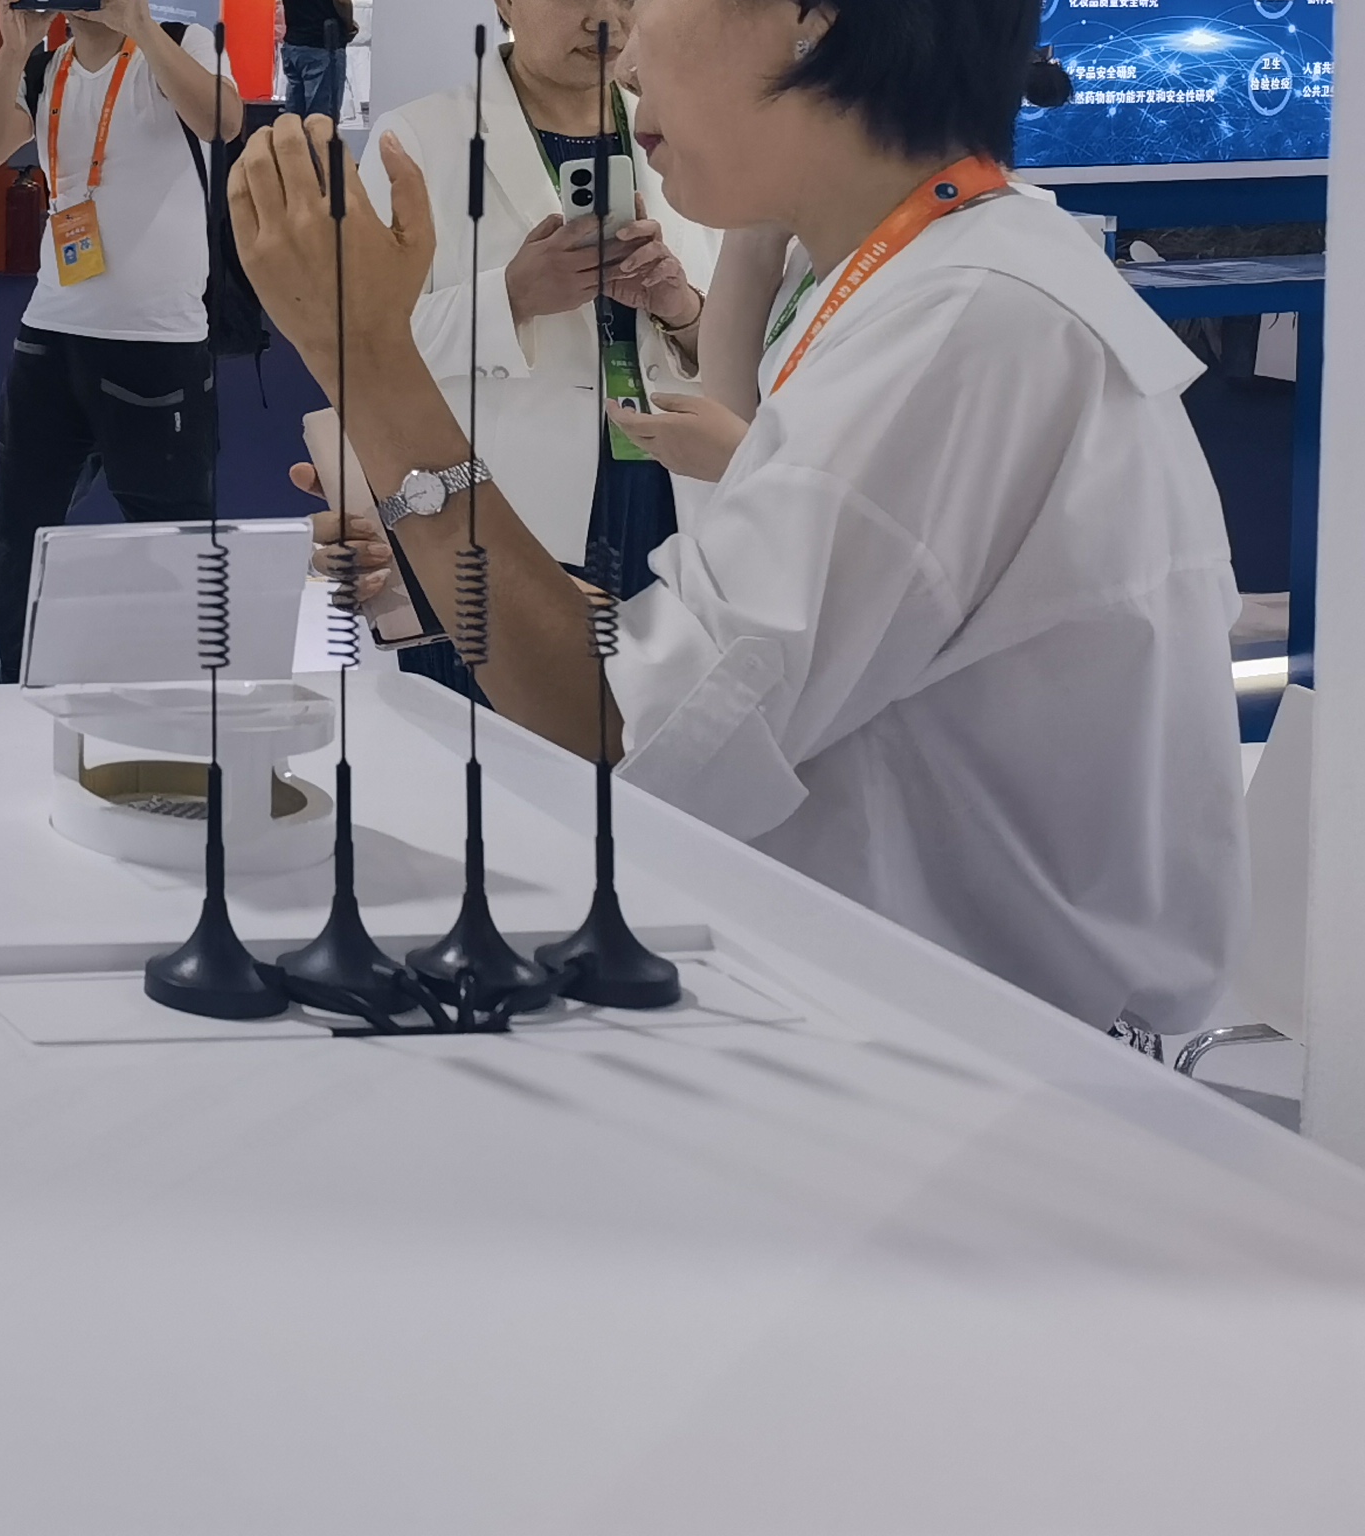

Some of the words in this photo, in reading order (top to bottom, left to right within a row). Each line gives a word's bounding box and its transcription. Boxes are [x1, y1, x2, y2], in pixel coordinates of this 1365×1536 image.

[1260, 57, 1281, 71] 卫生
[1249, 76, 1291, 92] 检验检疫
